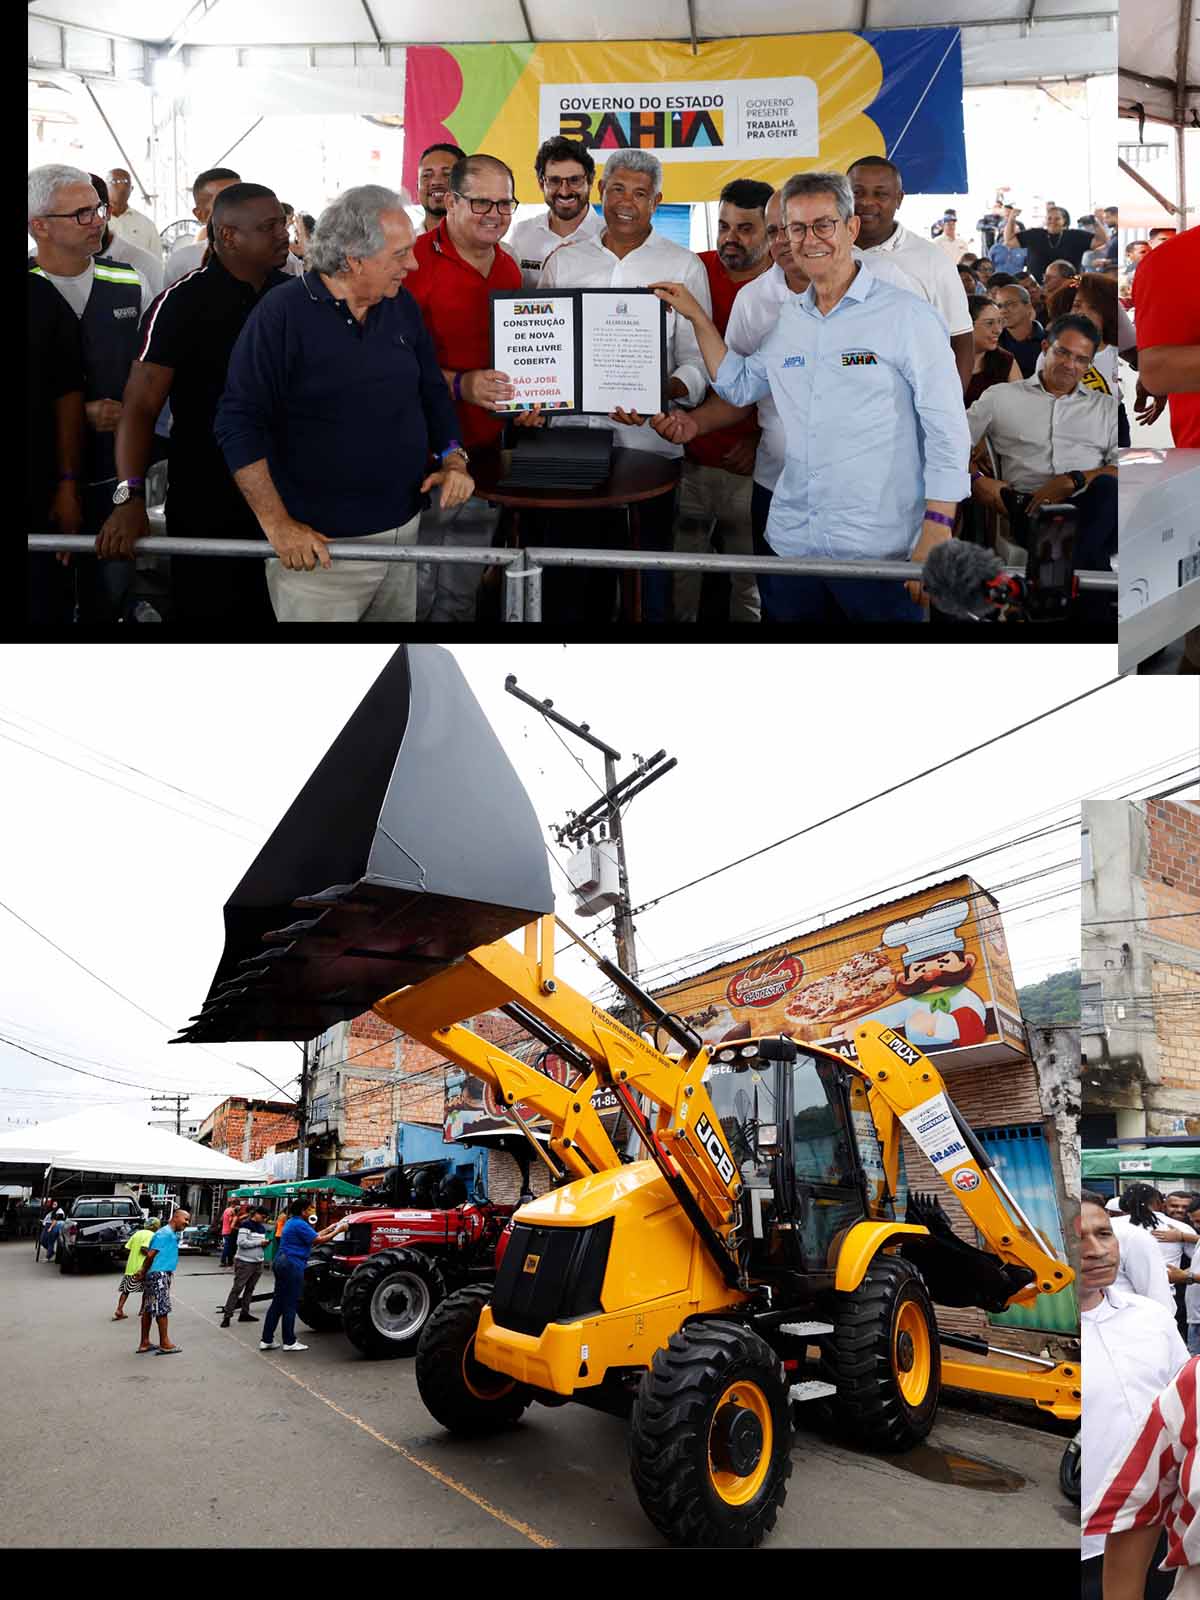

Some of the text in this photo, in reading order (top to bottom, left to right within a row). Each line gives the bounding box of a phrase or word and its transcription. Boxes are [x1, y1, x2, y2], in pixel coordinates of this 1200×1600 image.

[560, 95, 724, 110] GOVERNO DO ESTADO
[746, 98, 794, 109] GOVERNO
[746, 108, 790, 117] PRESENTE
[560, 110, 724, 149] BAHIA
[746, 120, 796, 129] TRABALHA
[747, 129, 799, 140] PRA GENTE
[514, 304, 554, 315] BAHIA
[514, 332, 555, 340] DE NOVA
[507, 344, 562, 353] FEIRA LIVRE
[513, 357, 556, 366] COBERTA
[696, 1124, 735, 1184] JCB
